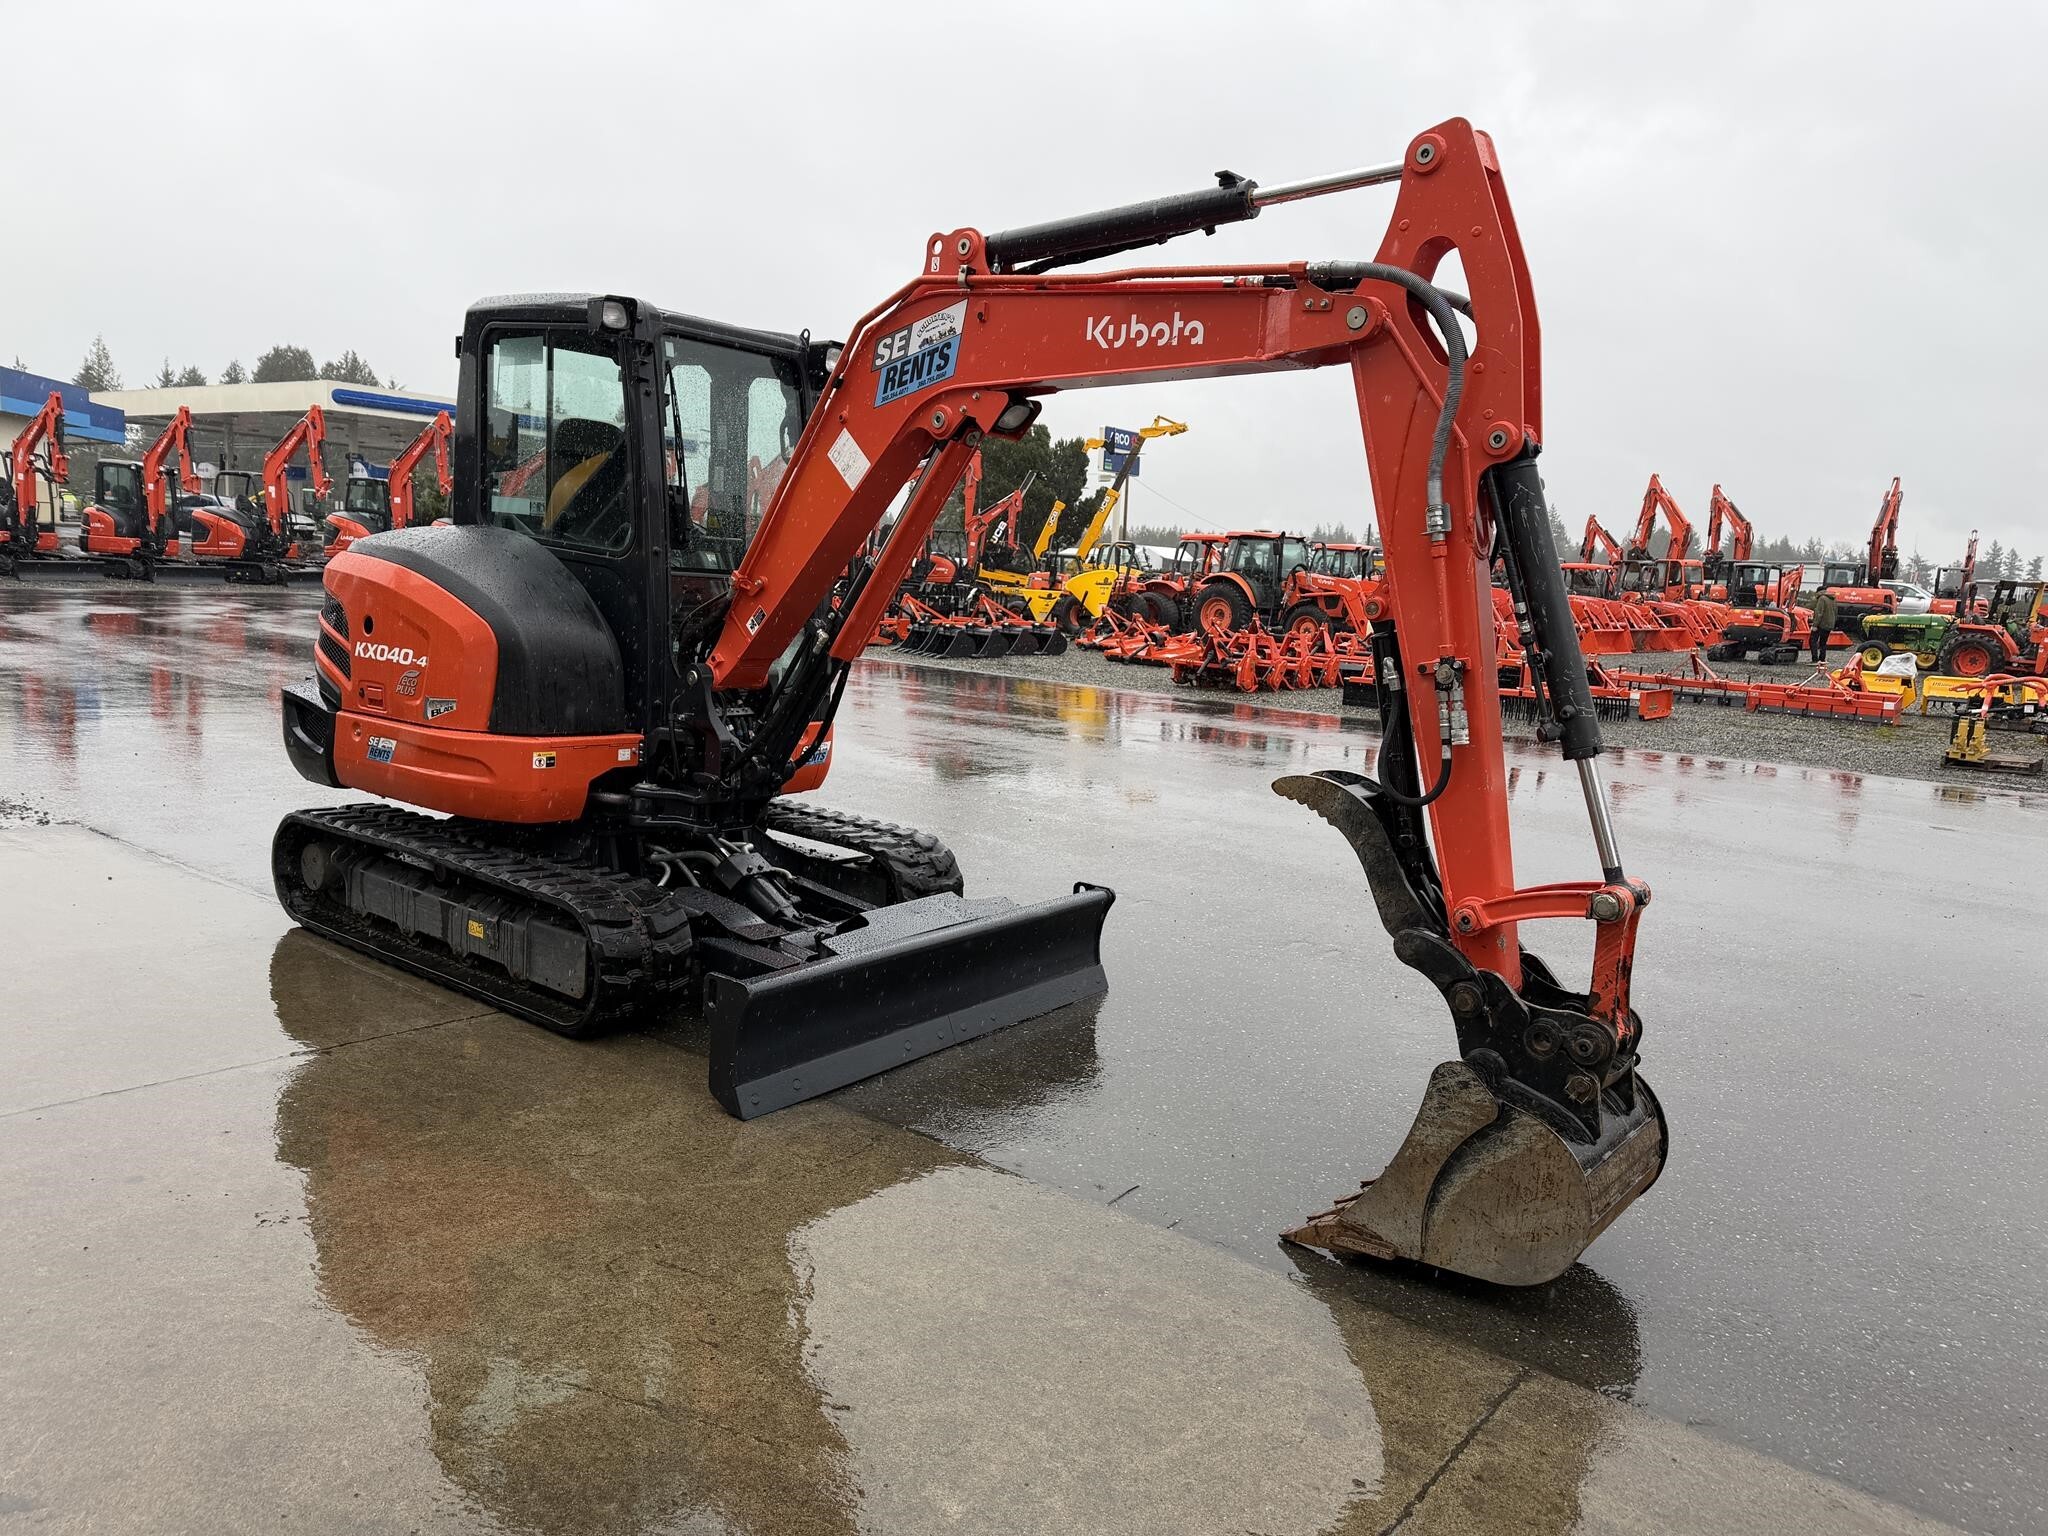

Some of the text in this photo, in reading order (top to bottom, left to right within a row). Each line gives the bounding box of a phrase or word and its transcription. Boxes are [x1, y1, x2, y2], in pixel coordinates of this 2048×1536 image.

[1086, 311, 1205, 349] Kubota
[875, 329, 908, 366] SE
[882, 341, 952, 395] RENTS
[1099, 495, 1112, 514] JCB
[1048, 510, 1060, 527] JCB
[991, 520, 1008, 544] JCB
[355, 641, 428, 668] KX040-4
[396, 684, 416, 696] PLUS
[401, 676, 418, 687] eco
[368, 736, 380, 747] SE
[369, 747, 391, 760] RENTS
